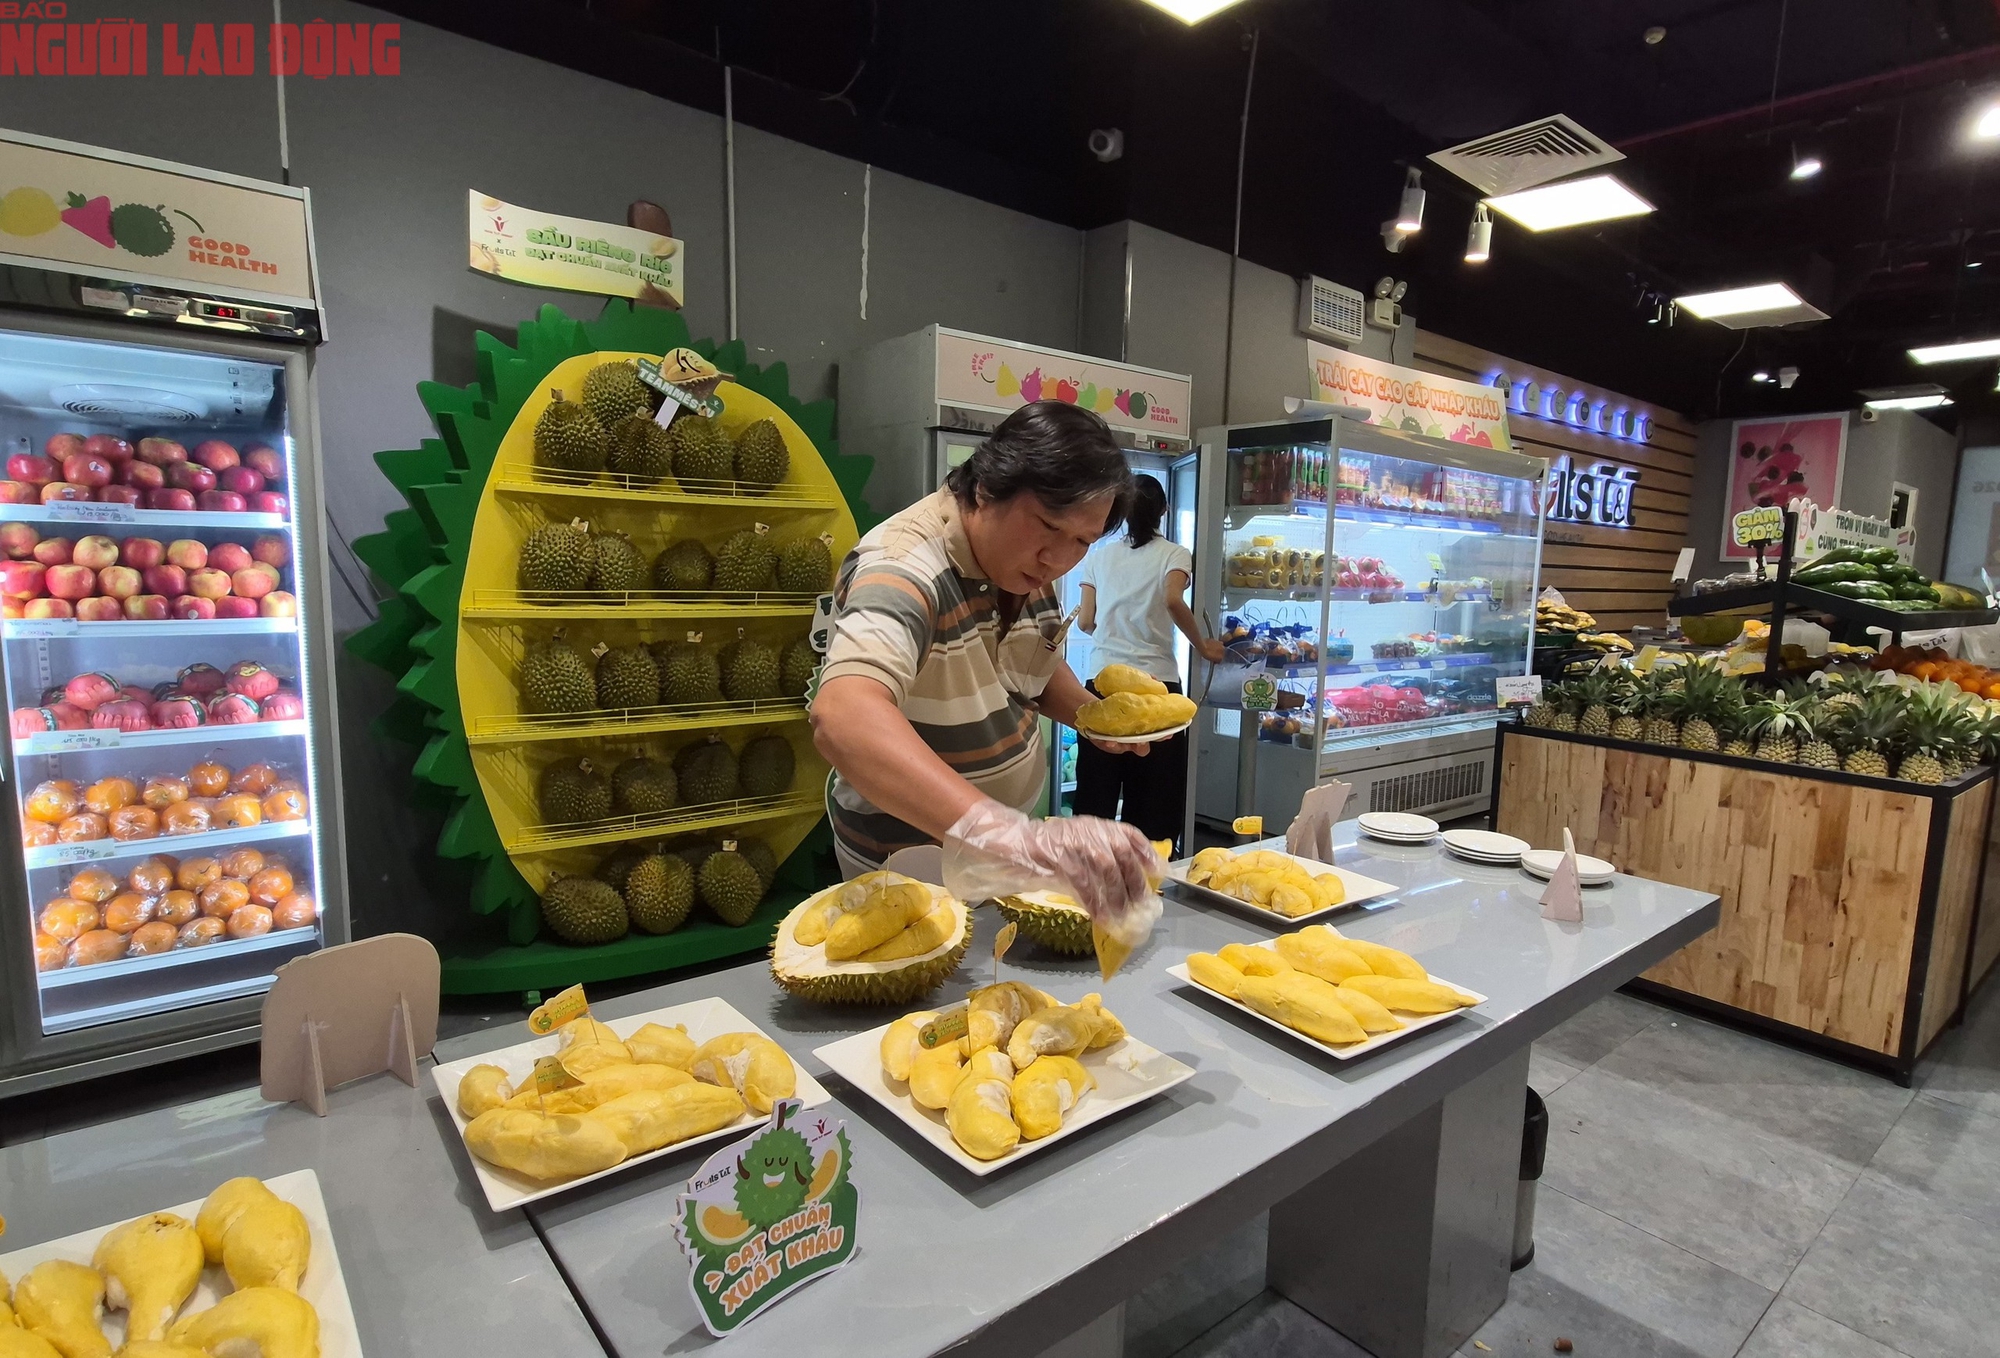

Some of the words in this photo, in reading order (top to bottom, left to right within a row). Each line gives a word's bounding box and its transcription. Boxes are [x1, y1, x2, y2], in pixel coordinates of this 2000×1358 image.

[188, 235, 251, 257] GOOD
[576, 238, 637, 264] RIÊNG
[189, 249, 278, 275] HEALTH
[1316, 359, 1347, 391] TRÁI
[1348, 368, 1374, 397] CÂY
[1375, 377, 1403, 404] CAO
[1150, 413, 1178, 424] HEALTH
[1151, 406, 1170, 415] GOOD
[1737, 522, 1783, 544] 30%
[726, 1234, 766, 1273] ĐẠT
[769, 1200, 831, 1243] CHUẨN
[721, 1252, 781, 1314] XUẤT
[786, 1220, 843, 1267] KHẨU
